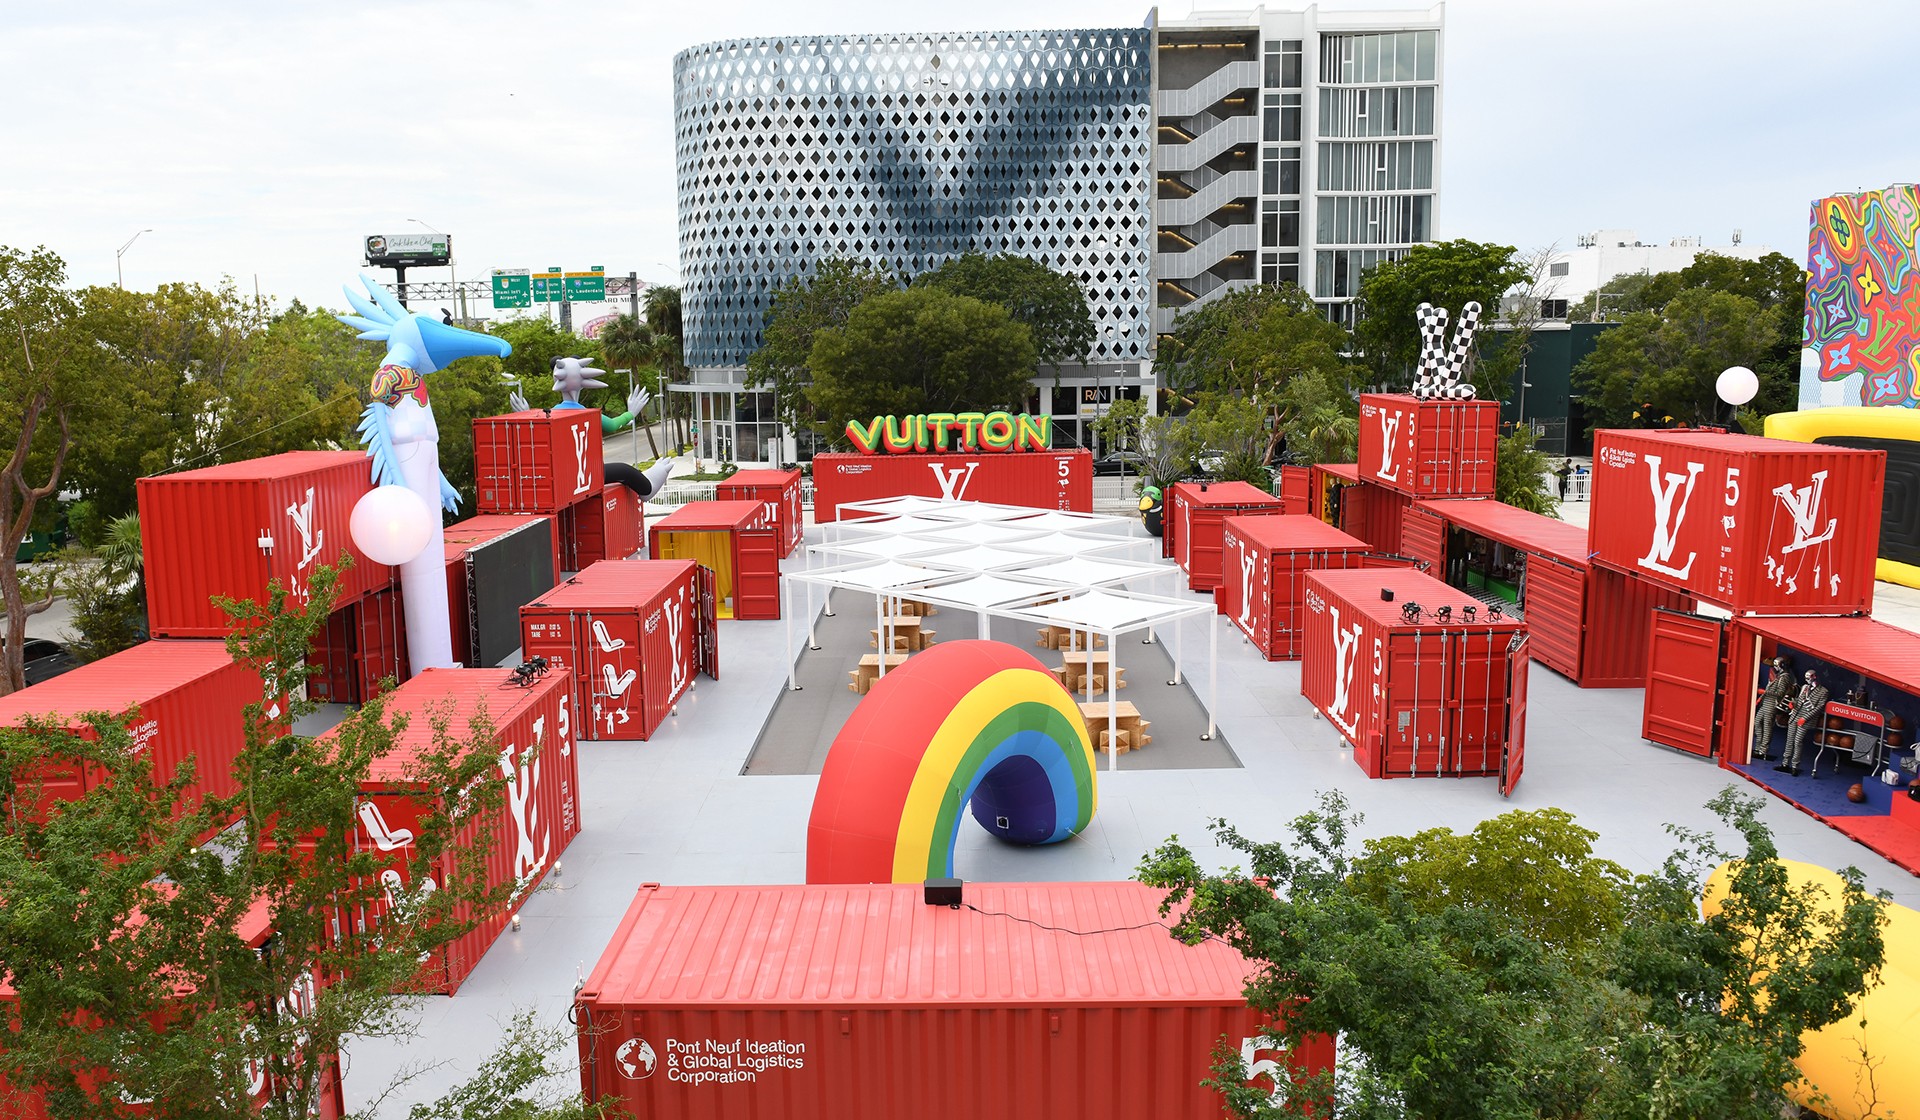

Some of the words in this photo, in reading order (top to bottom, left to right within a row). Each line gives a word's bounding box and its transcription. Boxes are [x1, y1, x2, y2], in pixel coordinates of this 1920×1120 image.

[846, 411, 1052, 455] VUITTON
[1408, 412, 1415, 436] 5
[1058, 460, 1070, 477] 5
[1725, 467, 1740, 507] 5
[1638, 454, 1704, 580] LV
[1373, 637, 1383, 677] 5
[558, 695, 569, 739] 5
[1831, 706, 1850, 715] LOUIS
[1850, 710, 1877, 721] VUITTON
[666, 1038, 701, 1054] Pont
[705, 1038, 741, 1054] Neuf
[746, 1039, 805, 1055] Ideation
[667, 1054, 679, 1067] &
[683, 1054, 732, 1069] Global
[737, 1054, 804, 1072] Logistics
[668, 1068, 756, 1086] Corporation
[1240, 1035, 1292, 1115] 5
